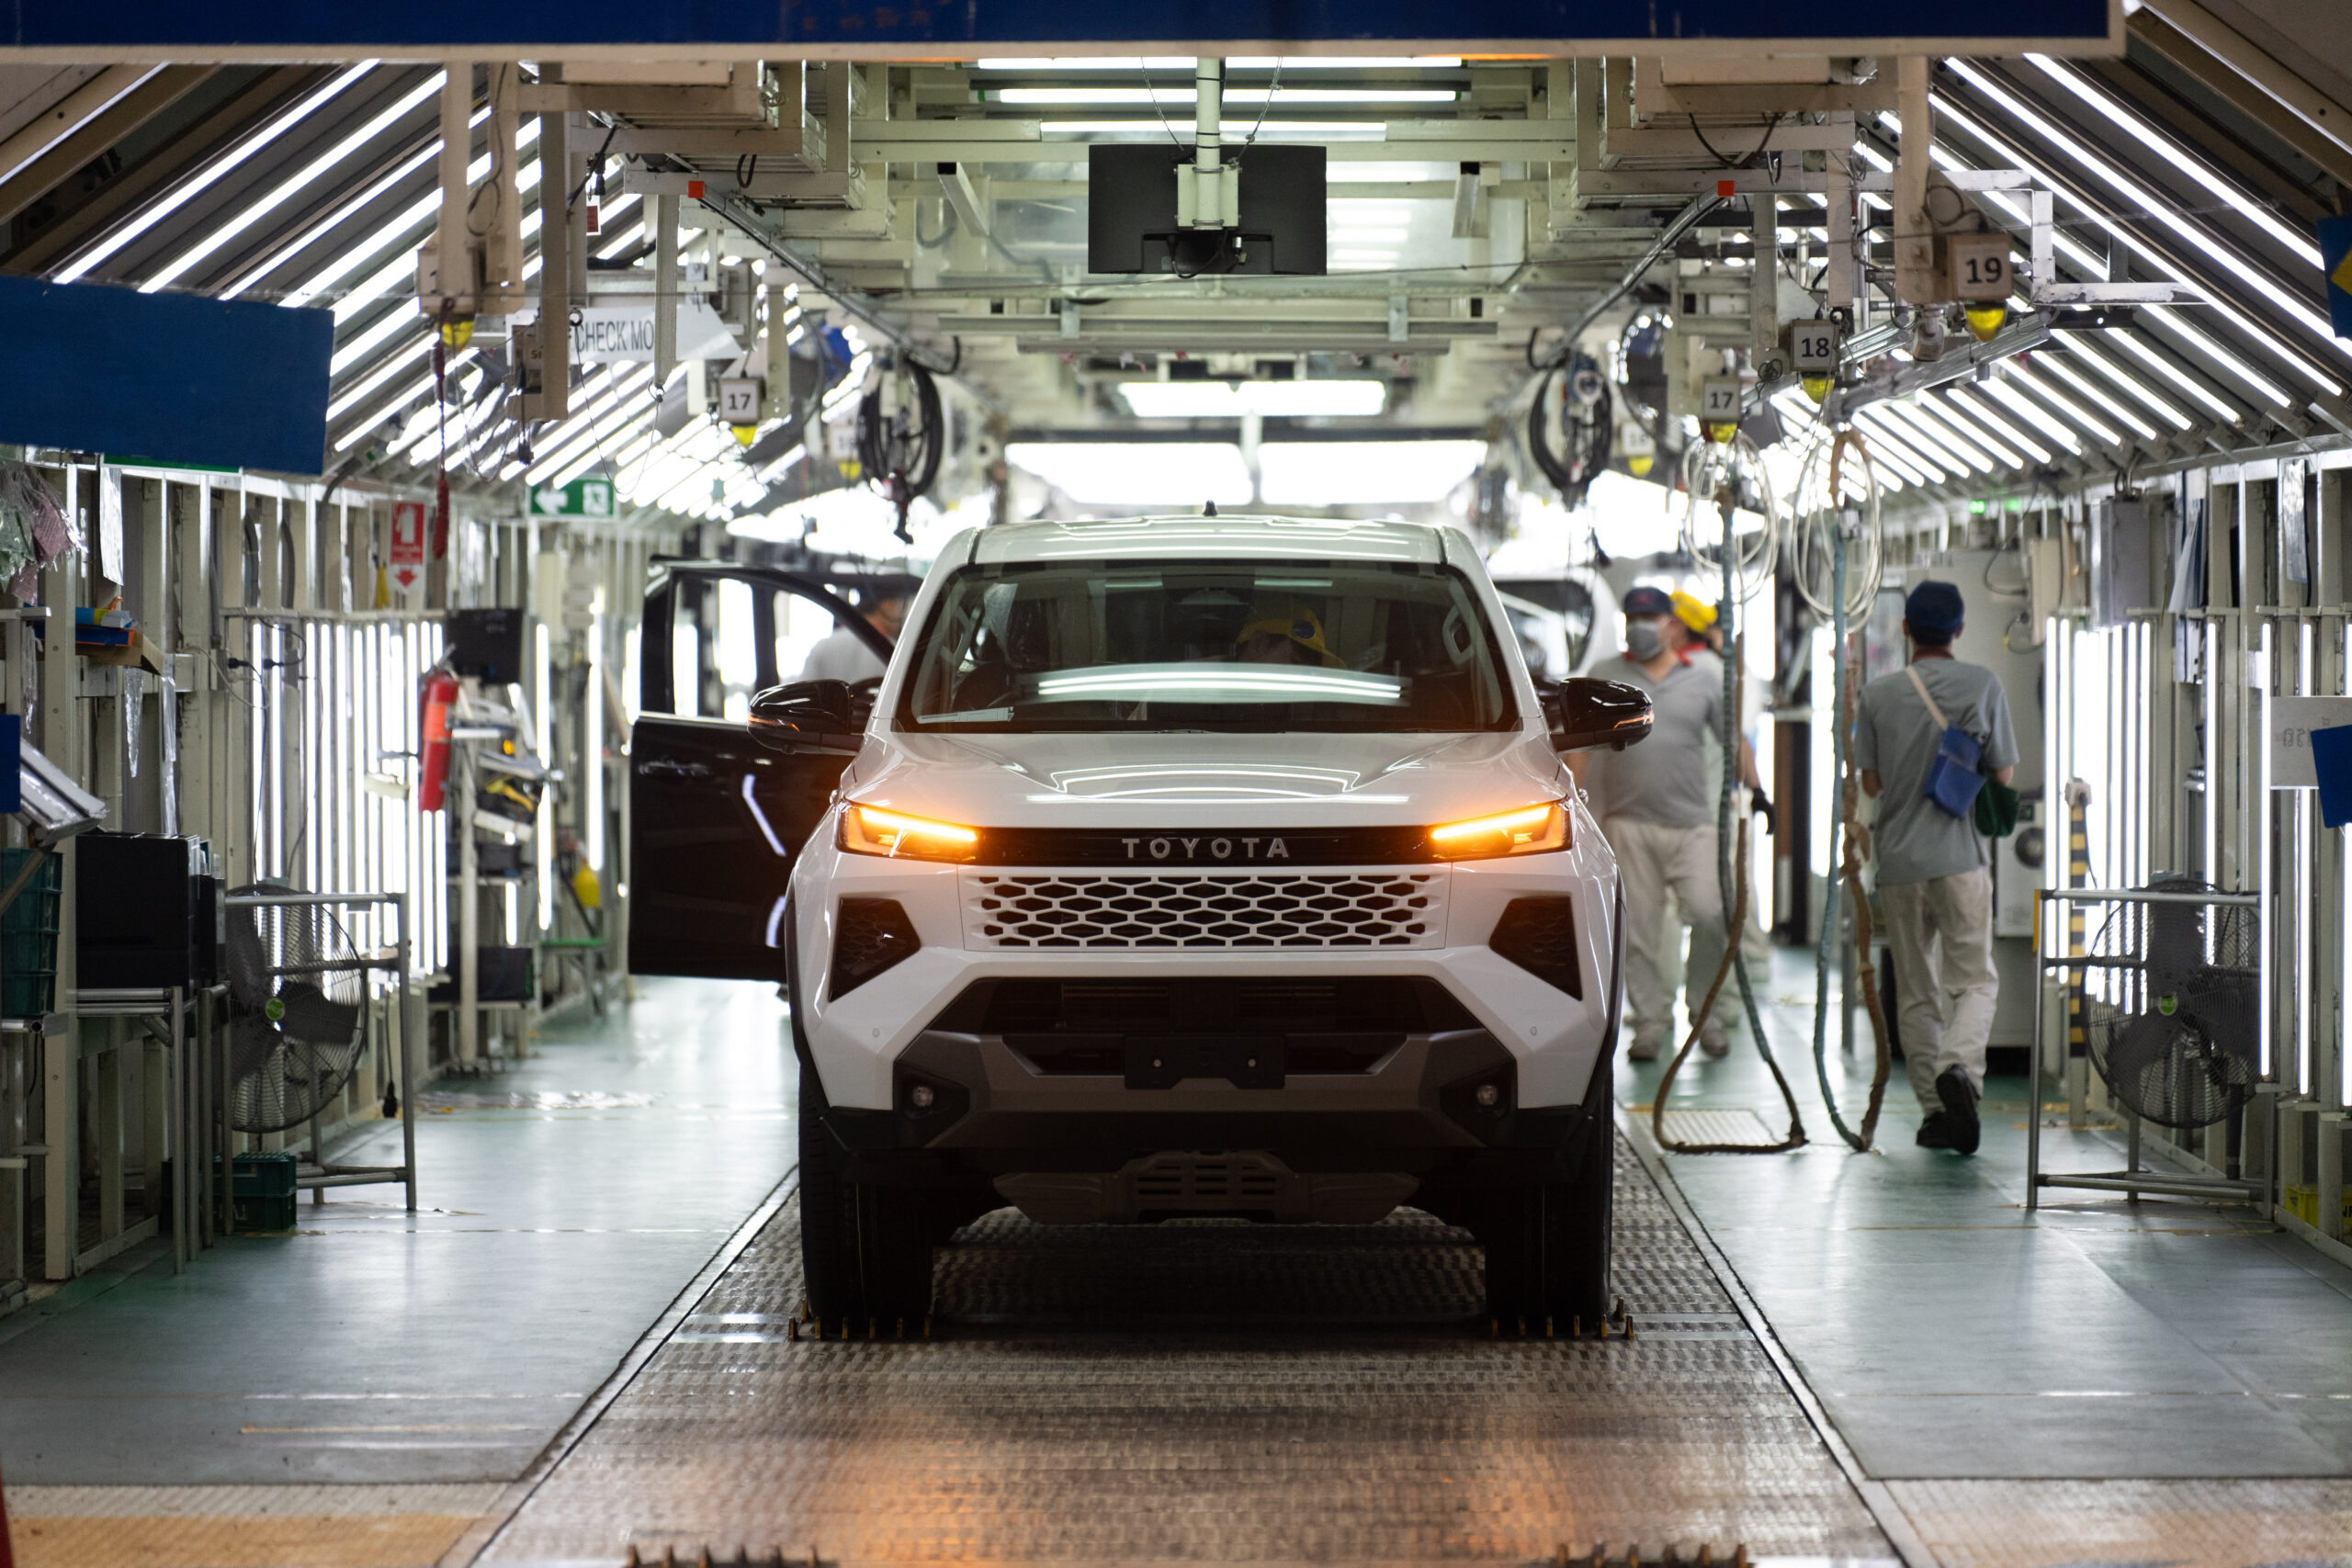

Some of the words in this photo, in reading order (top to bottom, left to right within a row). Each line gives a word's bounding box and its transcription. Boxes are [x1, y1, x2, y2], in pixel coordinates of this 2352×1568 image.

[1966, 257, 2003, 284] 19
[576, 321, 627, 352] CHECK
[630, 320, 654, 350] MO
[1801, 337, 1830, 357] 18
[728, 393, 751, 411] 17
[1710, 391, 1734, 409] 17
[1122, 838, 1289, 859] TOYOTA
